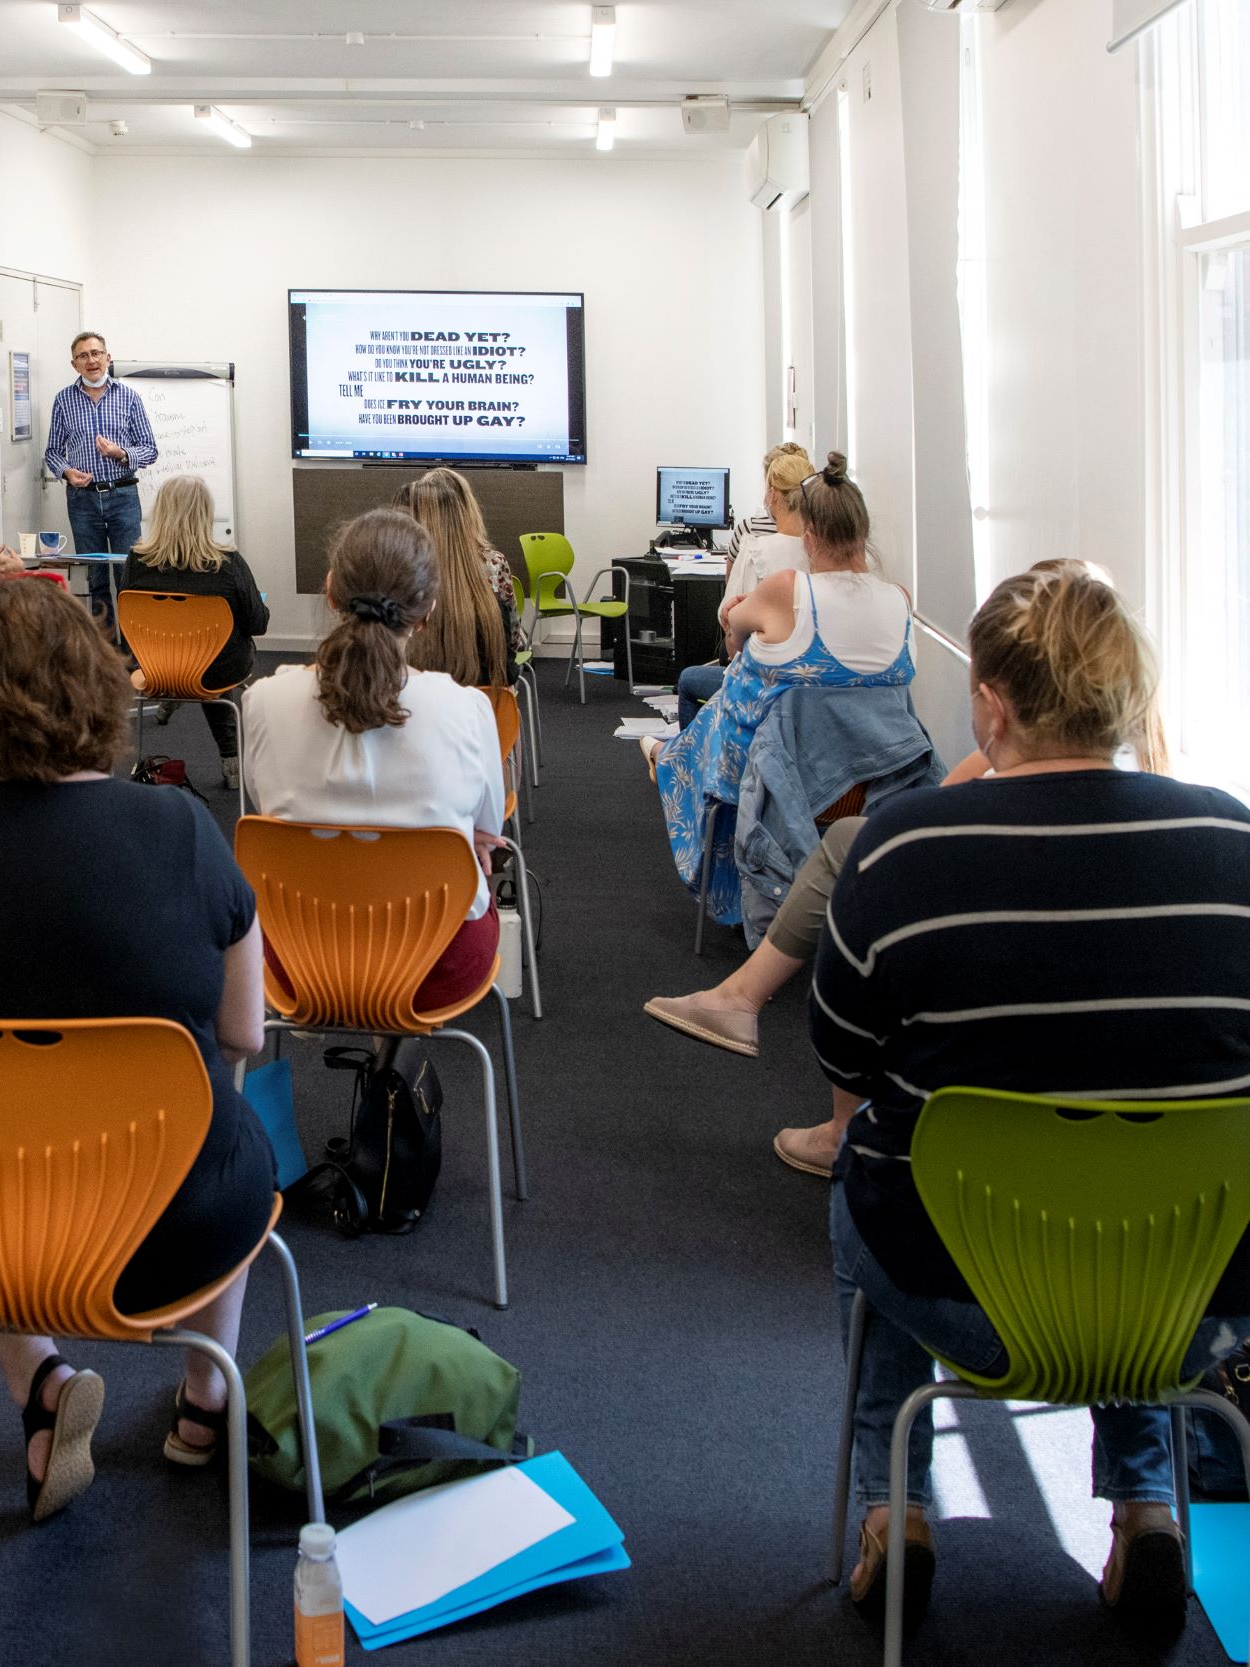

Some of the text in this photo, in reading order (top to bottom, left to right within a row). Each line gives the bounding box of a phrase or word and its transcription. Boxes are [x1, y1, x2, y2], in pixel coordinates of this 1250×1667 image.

[370, 331, 381, 341] WHY
[400, 331, 410, 341] YOU
[410, 332, 460, 342] DEAD
[464, 332, 511, 343] YET?
[367, 344, 375, 354] DO
[375, 344, 385, 354] YOU
[472, 346, 526, 357] IDIOT?
[382, 358, 393, 369] YOU
[409, 359, 445, 370] YOU'RE
[449, 359, 507, 371] UGLY?
[394, 372, 440, 383] KILL
[442, 372, 449, 383] A
[452, 373, 493, 384] HUMAN
[495, 373, 535, 385] BEING?
[338, 384, 364, 397] TELL ME
[386, 399, 422, 410] FRY
[426, 400, 465, 411] YOUR
[467, 401, 520, 412] BRAIN?
[358, 413, 371, 424] HAVE
[372, 413, 383, 424] YOU
[397, 414, 449, 426] BROUGHT
[452, 415, 473, 426] UP
[476, 416, 526, 427] GAY?
